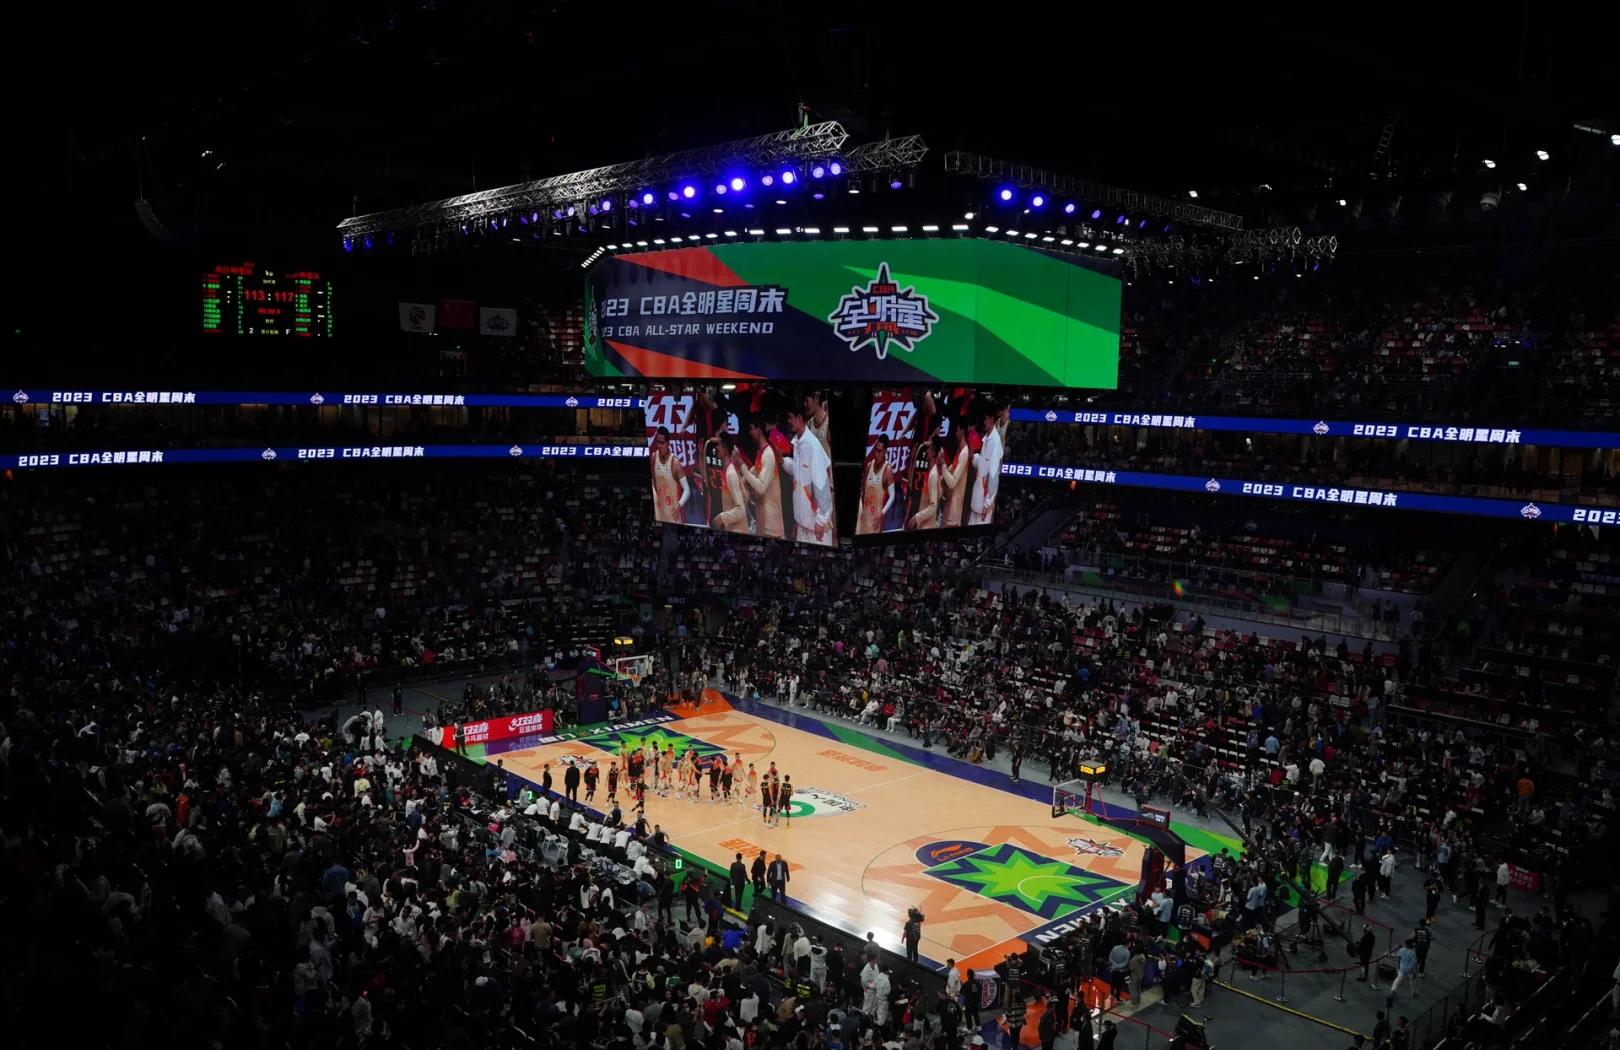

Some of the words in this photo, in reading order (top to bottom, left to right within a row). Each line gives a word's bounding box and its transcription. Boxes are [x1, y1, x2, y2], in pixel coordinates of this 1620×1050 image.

[639, 288, 785, 316] CBA全明星周末
[618, 325, 640, 337] CBA
[645, 323, 700, 336] ALL-STAR
[706, 322, 774, 335] WEEKEND
[52, 392, 93, 403] 2023
[102, 391, 196, 404] CBA全明星周末
[343, 394, 378, 404] 2023
[385, 394, 465, 406] CBA全明星周末
[597, 398, 631, 407] 2023
[1074, 412, 1107, 423] 2023
[1113, 414, 1196, 428] CBA全明星周末
[1353, 424, 1398, 437] 2023
[1407, 426, 1521, 444] CBA全明星周末
[18, 454, 60, 467] 2023
[68, 450, 164, 464] CBA全明星周末
[298, 448, 335, 459] 2023
[342, 446, 425, 458] CBA全明星周末
[542, 446, 577, 456] 2023
[1001, 464, 1033, 476] 2023
[1038, 466, 1117, 484] CBA全明星周末
[1242, 482, 1284, 496] 2023
[1292, 486, 1398, 507] CBA全明星周末
